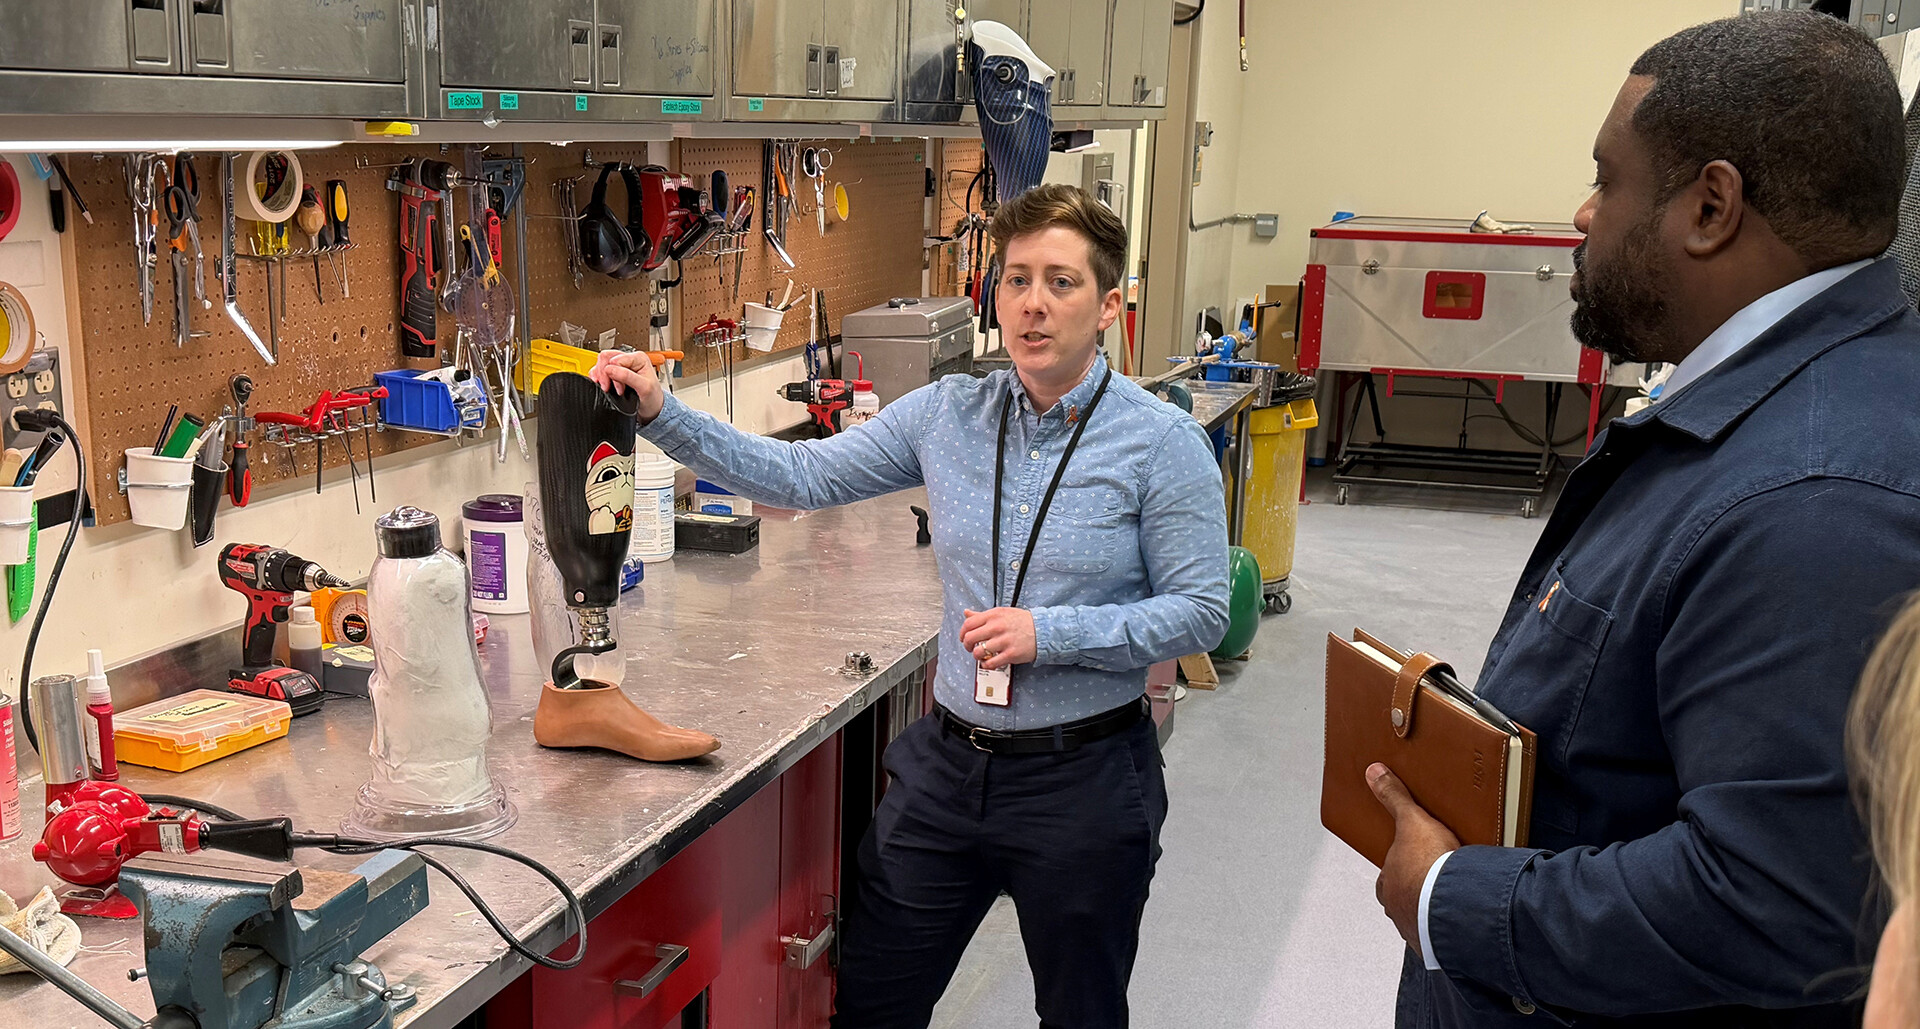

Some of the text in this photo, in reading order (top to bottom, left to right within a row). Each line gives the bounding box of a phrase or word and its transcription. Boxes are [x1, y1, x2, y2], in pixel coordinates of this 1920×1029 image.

[450, 95, 481, 106] Tape Stock
[663, 102, 678, 111] Fabtech
[690, 102, 700, 112] Stock
